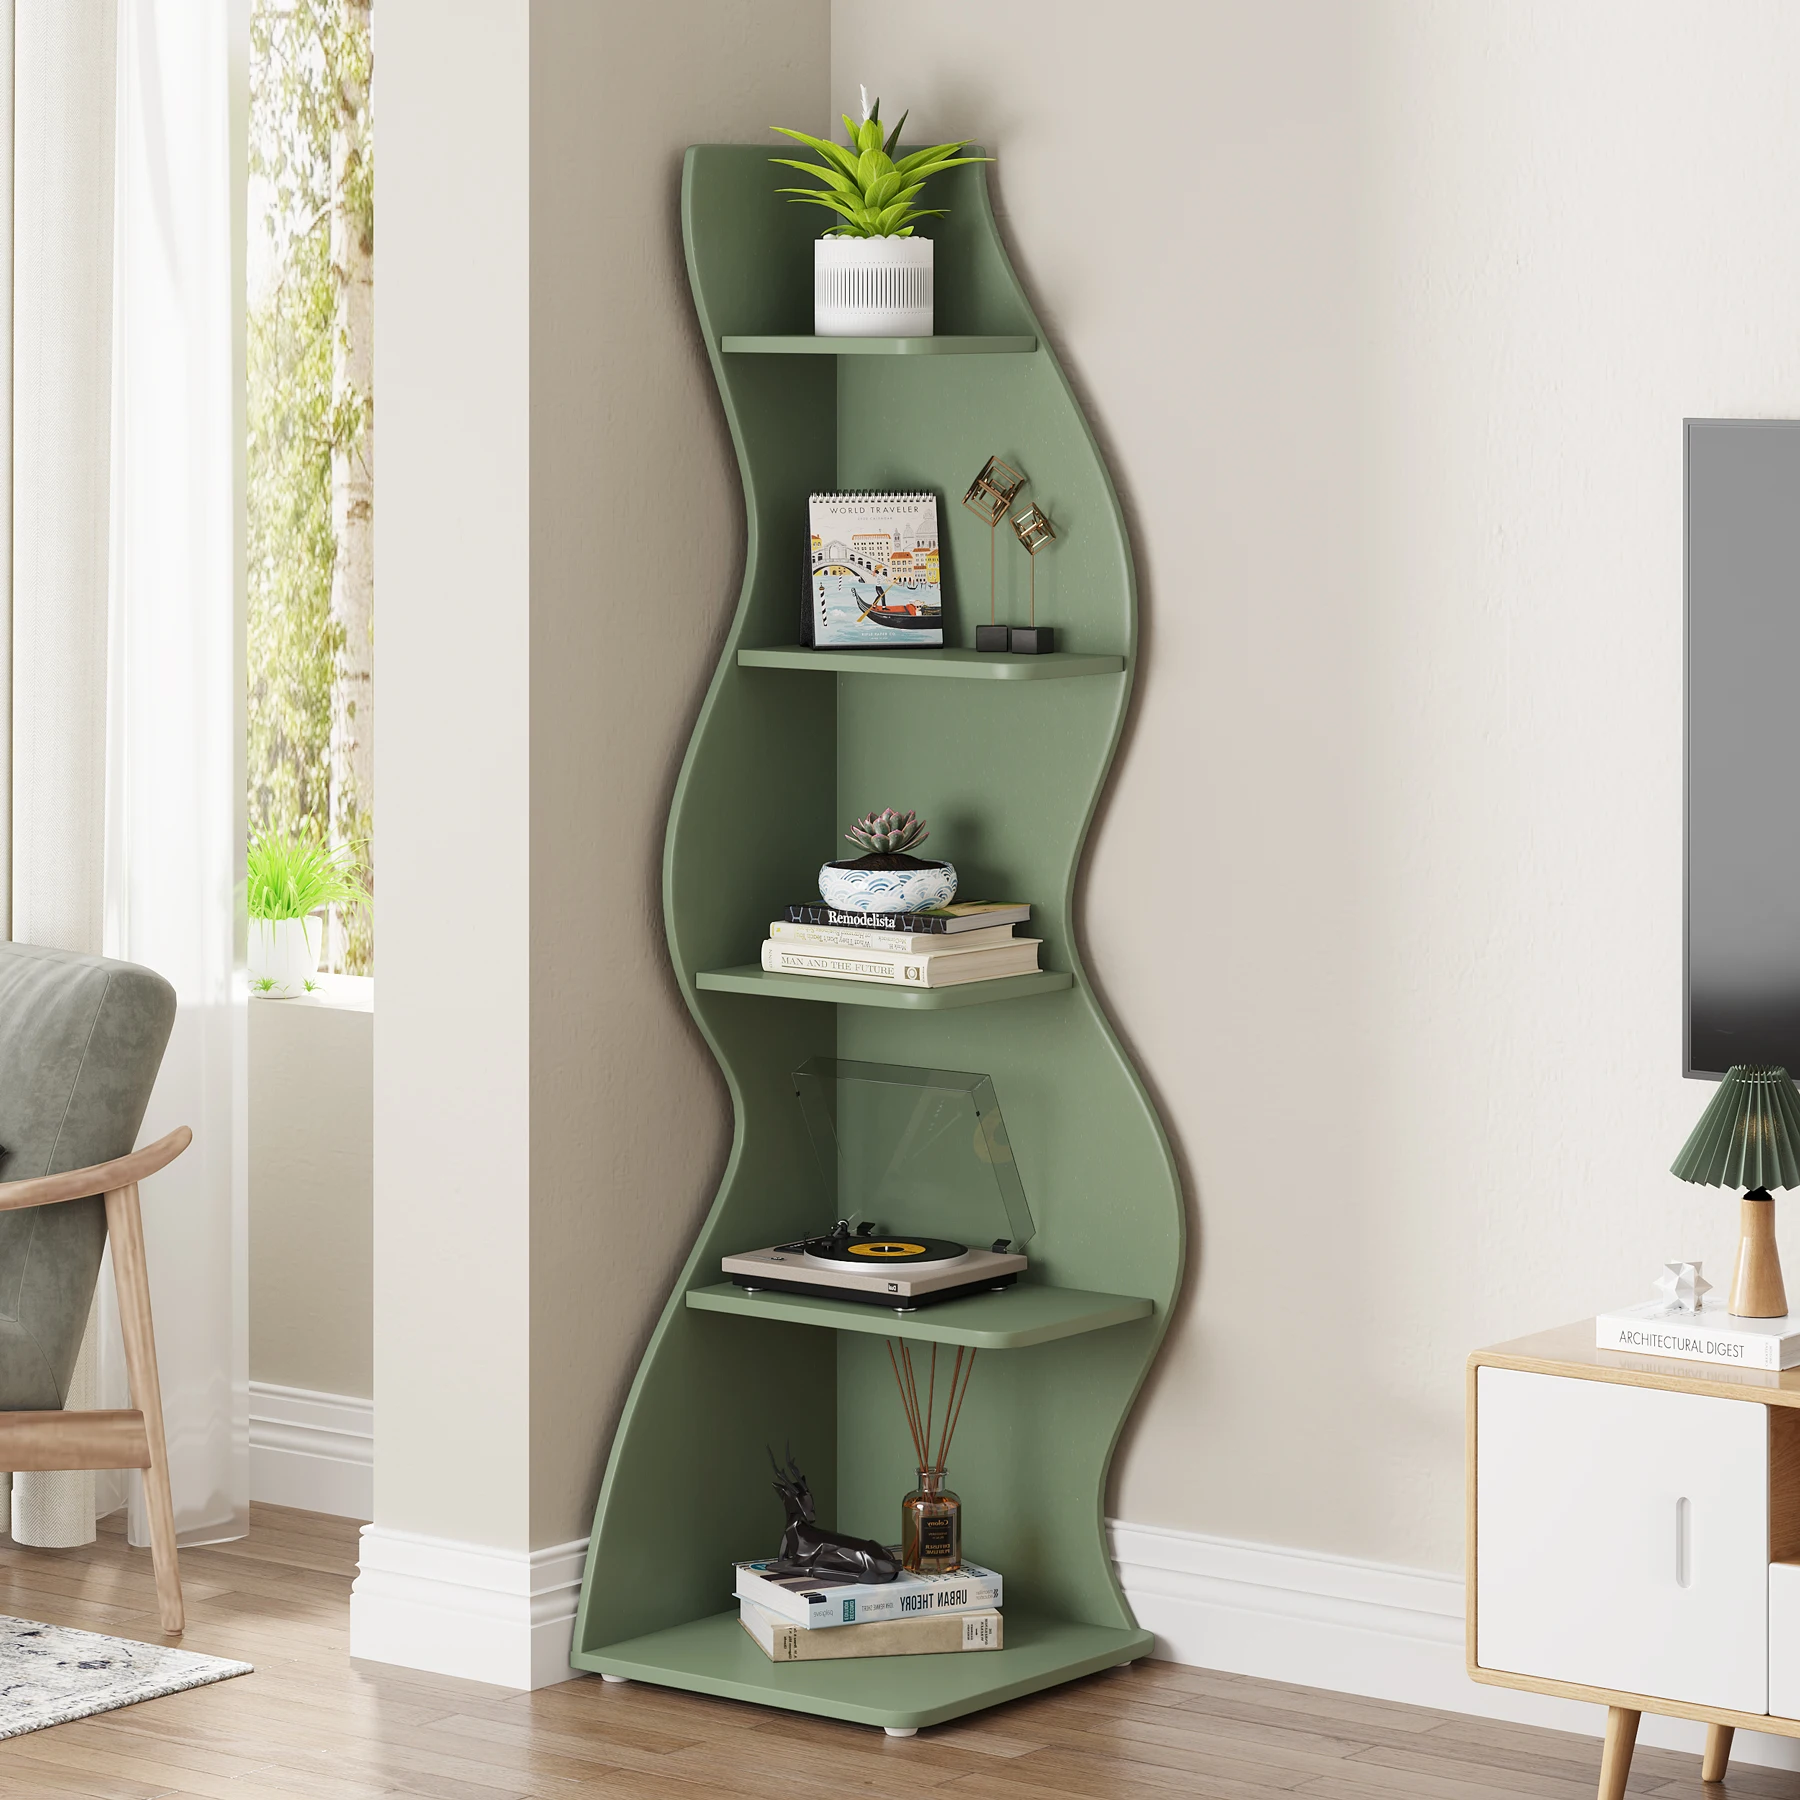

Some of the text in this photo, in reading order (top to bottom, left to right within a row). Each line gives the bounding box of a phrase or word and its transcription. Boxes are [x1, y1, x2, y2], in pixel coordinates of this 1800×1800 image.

[829, 505, 920, 515] WORLD TRAVELER
[828, 909, 896, 928] Remodelista
[781, 956, 895, 975] MAN AND THE FUTURE
[1619, 1330, 1703, 1354] ARCHITECTURAL
[1706, 1341, 1745, 1359] DIGEST
